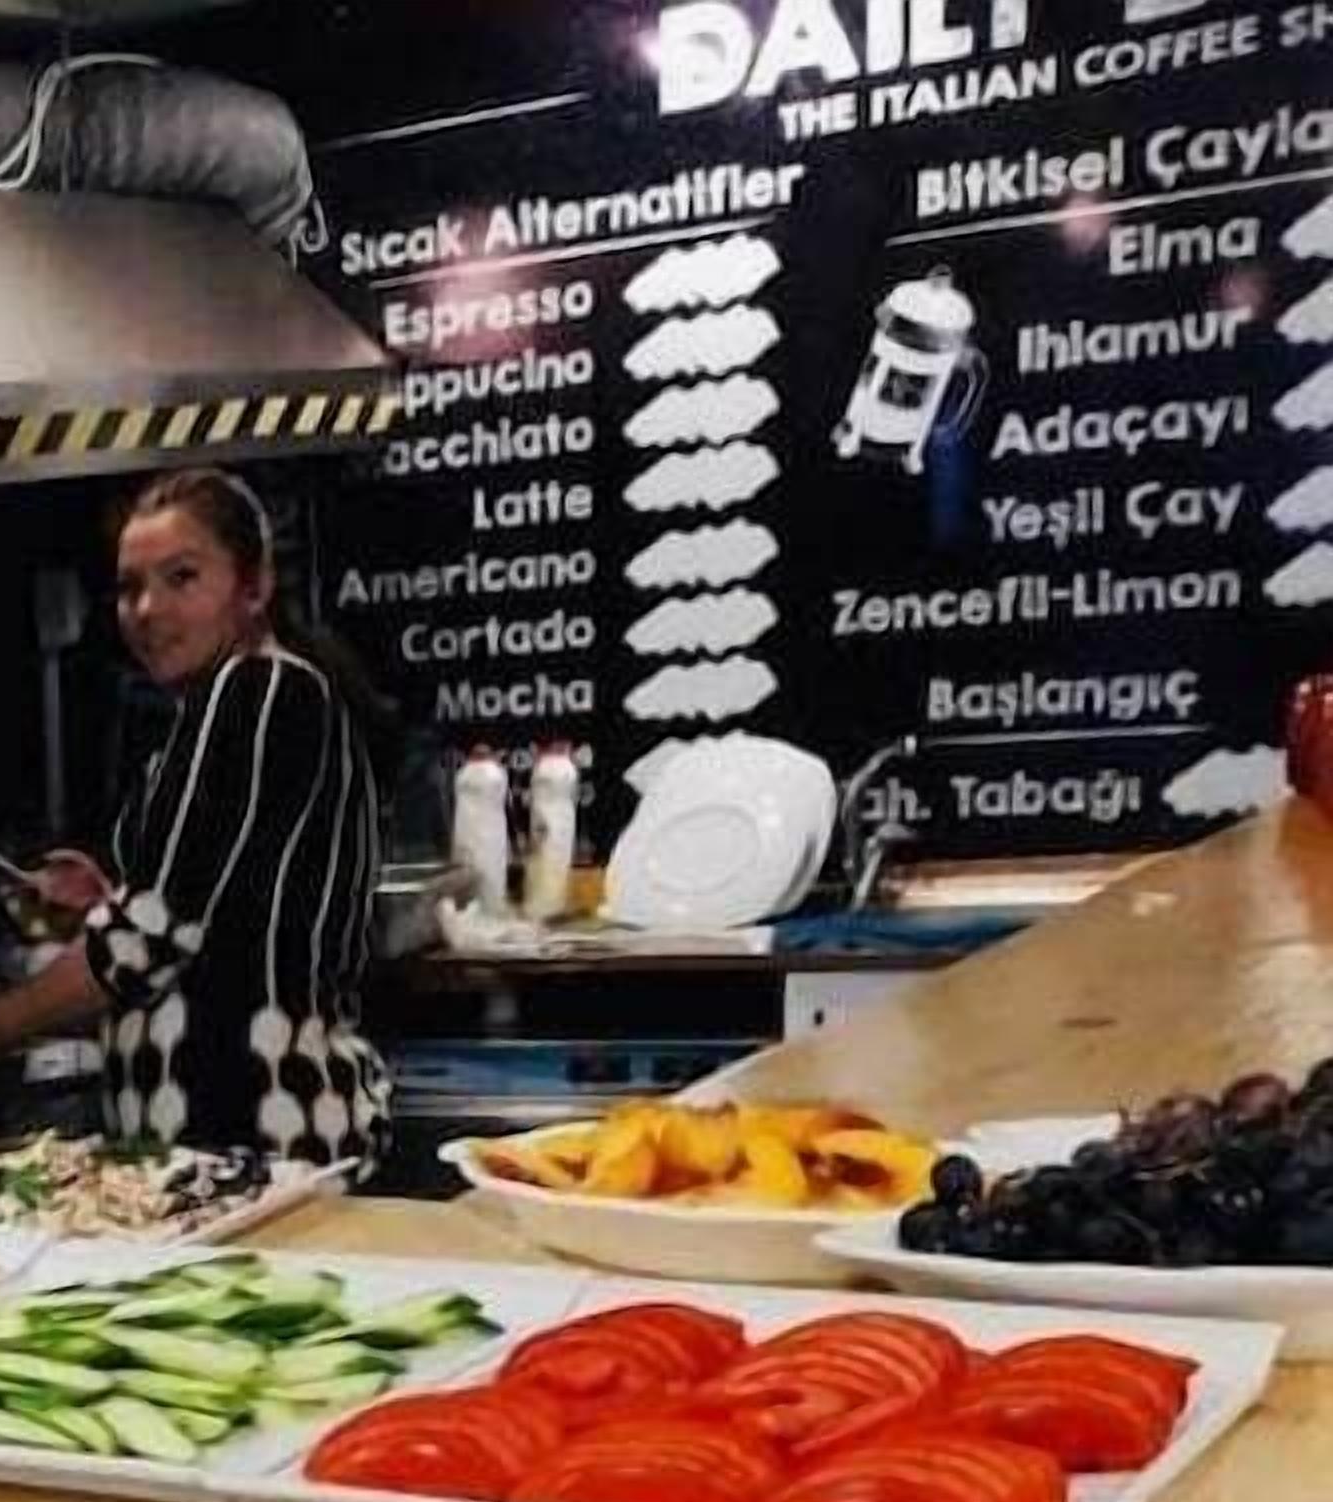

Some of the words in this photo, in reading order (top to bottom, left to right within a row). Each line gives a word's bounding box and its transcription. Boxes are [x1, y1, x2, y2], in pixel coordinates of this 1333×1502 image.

[779, 91, 857, 142] THE
[870, 56, 1057, 128] ITALIAN
[1073, 14, 1260, 87] COFFEE
[483, 164, 806, 254] Alternatifler
[916, 136, 1126, 219] Bitkisel
[1108, 216, 1260, 276] Elma
[384, 280, 594, 350] Espresso
[1017, 305, 1254, 375] Ihlamur
[403, 348, 594, 418] ppucino
[385, 412, 594, 475] acchiato
[989, 395, 1249, 460] Adaçayı
[472, 479, 594, 530] Latte
[980, 486, 1106, 550] Yeşil
[1125, 481, 1244, 539] Çay
[337, 548, 597, 608] Americano
[832, 568, 1242, 635] Zencefil-Limon
[401, 608, 597, 663] Cortado
[436, 672, 594, 722] Mocha
[927, 668, 1200, 728] Başlangıç
[841, 778, 933, 822] ah.
[949, 768, 1141, 823] Tabağı
